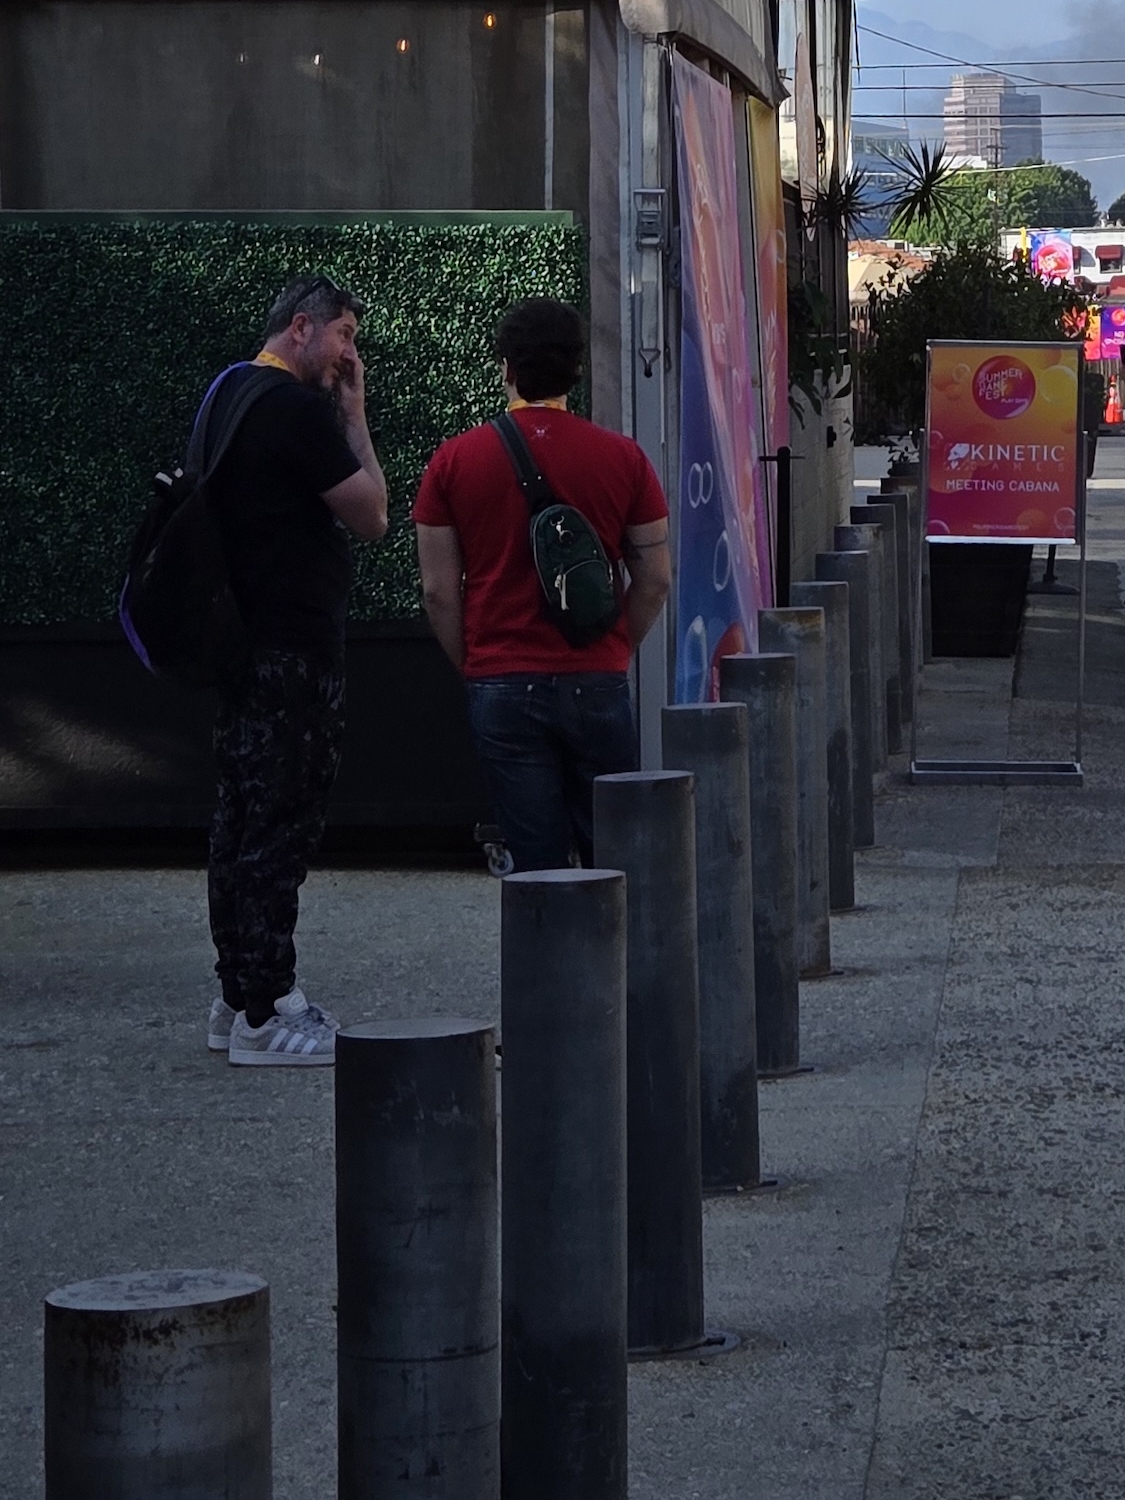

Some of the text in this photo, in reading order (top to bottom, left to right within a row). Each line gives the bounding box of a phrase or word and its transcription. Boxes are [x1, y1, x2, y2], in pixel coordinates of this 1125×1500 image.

[970, 444, 1065, 461] KINETIC
[946, 479, 1060, 492] MEETING CABANA
